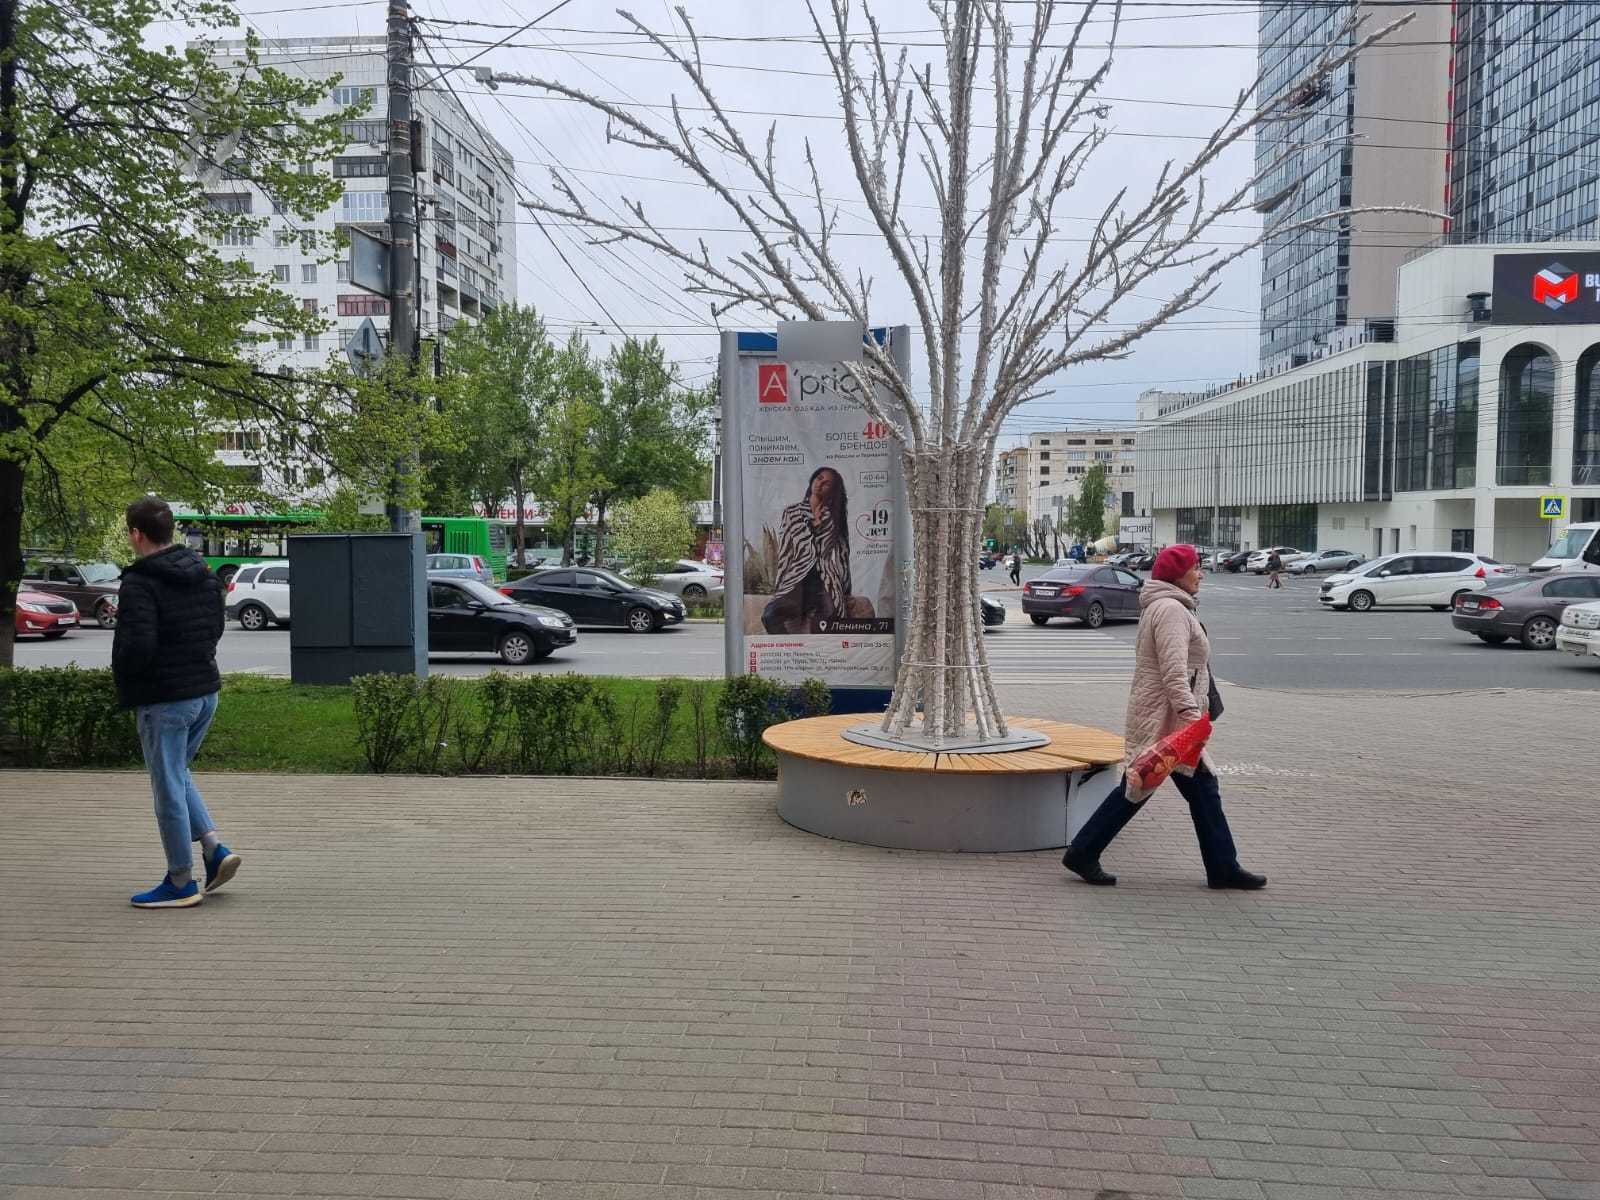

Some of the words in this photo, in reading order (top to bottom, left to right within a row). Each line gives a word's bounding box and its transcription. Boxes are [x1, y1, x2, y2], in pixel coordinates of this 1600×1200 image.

[825, 432, 859, 441] БОЛЕЕ
[872, 509, 889, 525] 19
[865, 527, 889, 537] лет
